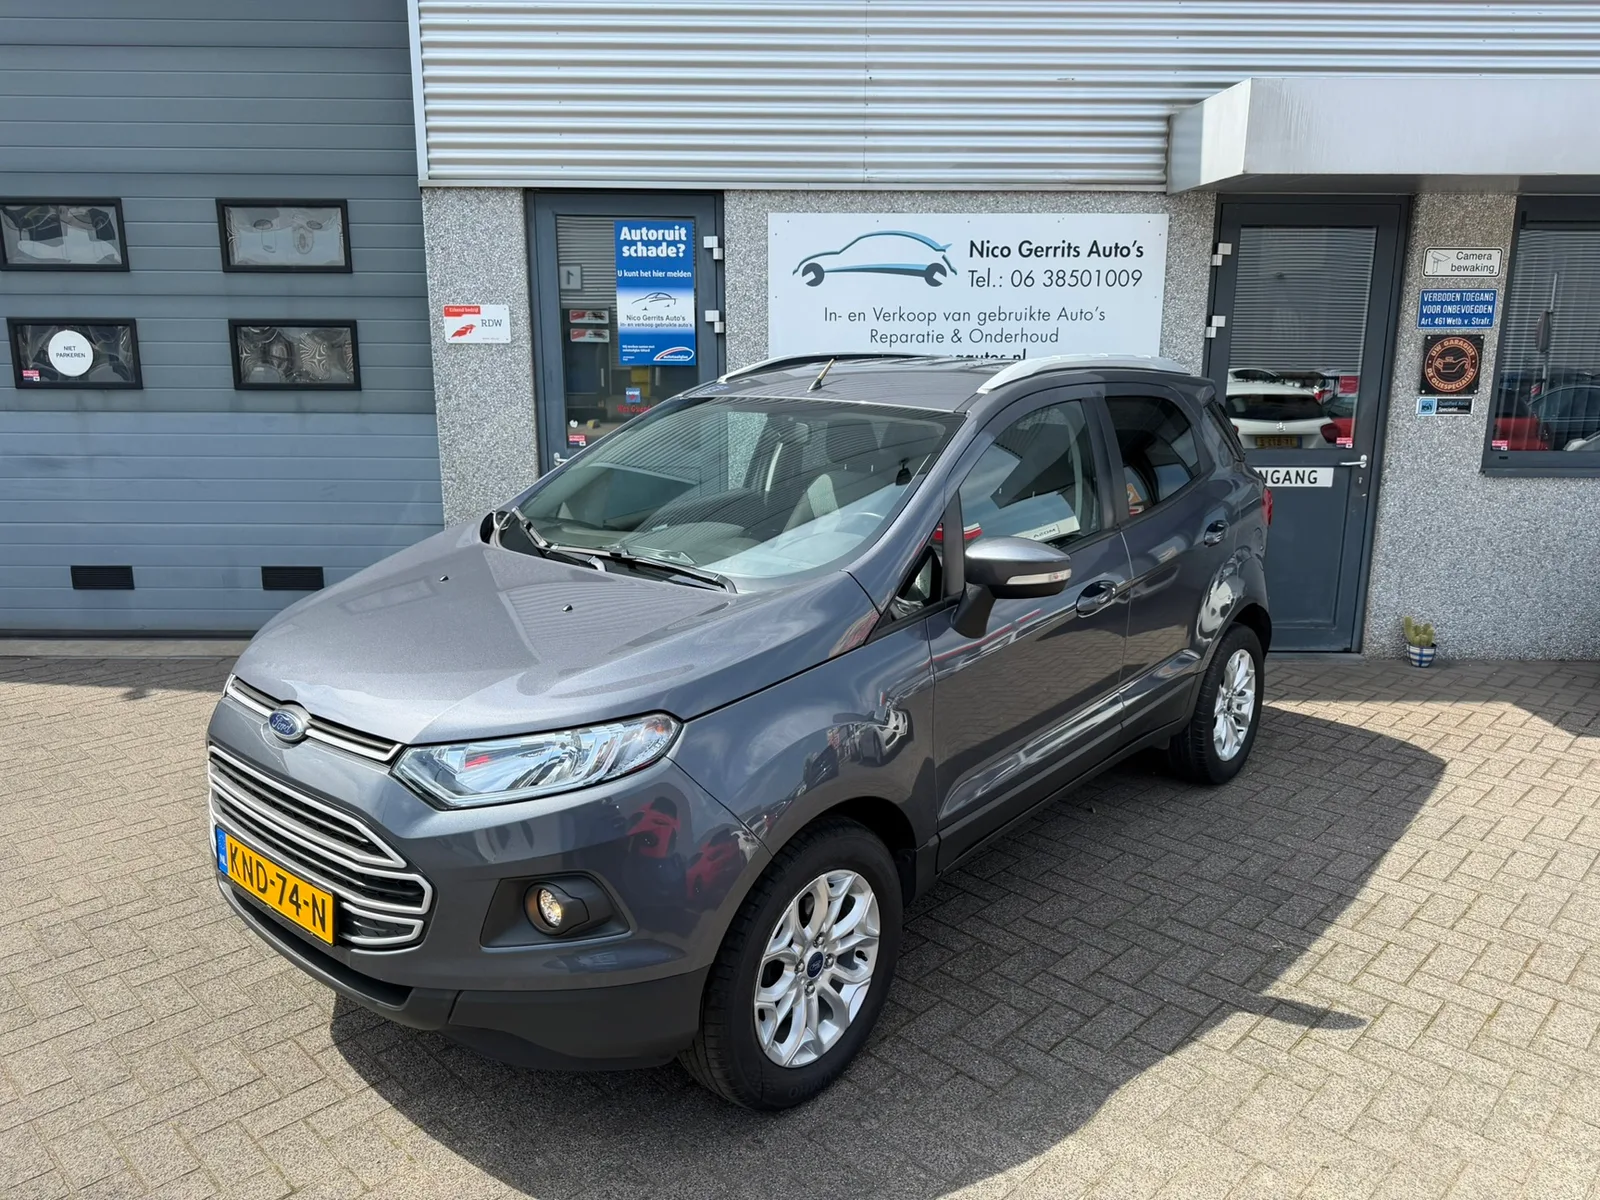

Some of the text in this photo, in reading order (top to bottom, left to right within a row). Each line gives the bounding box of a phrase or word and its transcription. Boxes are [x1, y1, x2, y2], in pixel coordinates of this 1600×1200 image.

[619, 225, 687, 241] Autoruit
[622, 241, 686, 258] schade?
[969, 239, 1144, 258] Nico Gerrits Auto's
[1456, 251, 1493, 261] Camera
[617, 269, 692, 278] U kunt het hier melden
[1450, 263, 1495, 274] bewaking
[967, 267, 1143, 288] Tel.: 06 38501009
[1423, 292, 1494, 302] VERBODEN TOEGANG
[824, 305, 1106, 326] In- en Verkoop van gebruikte Auto's
[1422, 304, 1493, 314] VOOR ONBEVOEGDEN
[481, 318, 503, 327] RDW
[1420, 317, 1433, 325] Art.
[1434, 317, 1446, 325] 461
[1471, 317, 1491, 325] Strafr.
[870, 327, 1059, 348] Reparatie & Onderhoud
[1431, 339, 1475, 357] UW GARAGIST
[1427, 368, 1475, 390] DE OLIESPECIALIST
[1258, 469, 1318, 485] NGANG
[272, 713, 294, 734] Ford
[229, 842, 326, 934] KND-74-N
